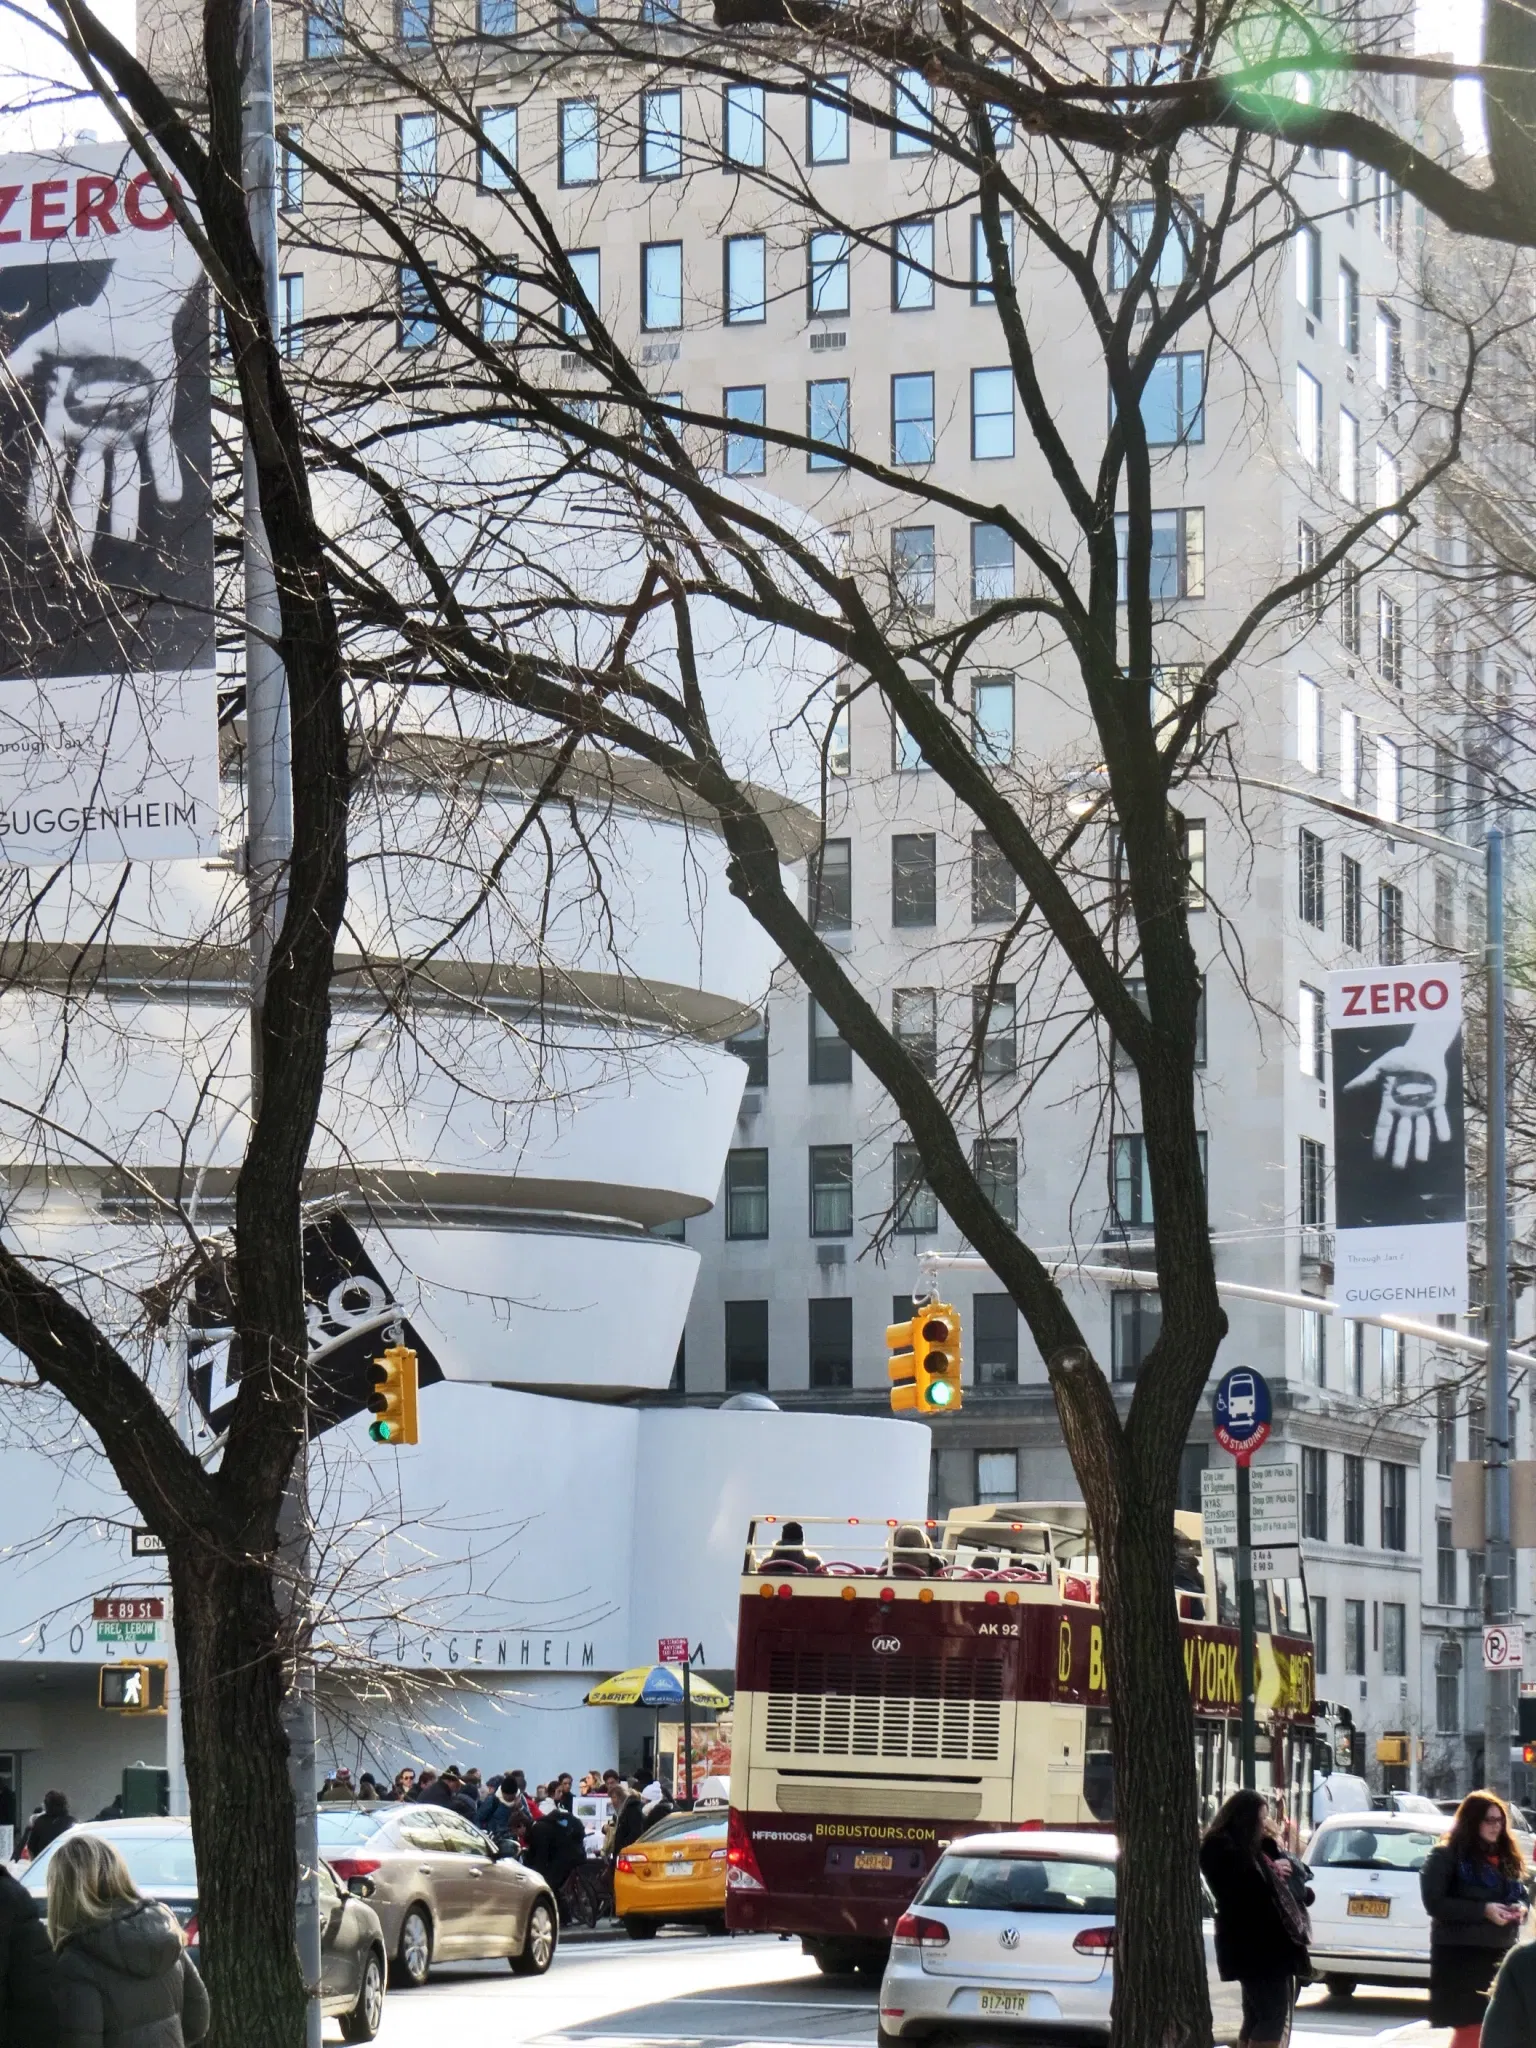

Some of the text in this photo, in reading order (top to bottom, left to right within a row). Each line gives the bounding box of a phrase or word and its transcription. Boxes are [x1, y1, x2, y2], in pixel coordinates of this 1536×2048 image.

[0, 741, 49, 754] rough
[1341, 979, 1449, 1016] ZERO
[1348, 1253, 1381, 1264] Through
[1345, 1285, 1456, 1302] GUGGENHEIM
[1218, 1424, 1265, 1451] NO STANDING
[1252, 1470, 1263, 1479] Drop
[1286, 1467, 1293, 1477] Up
[1254, 1563, 1257, 1571] E
[107, 1603, 151, 1618] E 89 St
[125, 1622, 153, 1635] LEBOW
[979, 1624, 1019, 1636] AK 92
[368, 1633, 595, 1667] GUGGENHEIM
[1198, 1638, 1238, 1703] YORK
[591, 1693, 637, 1701] SABRETT
[815, 1823, 936, 1841] BIGBUSTOURS.COM
